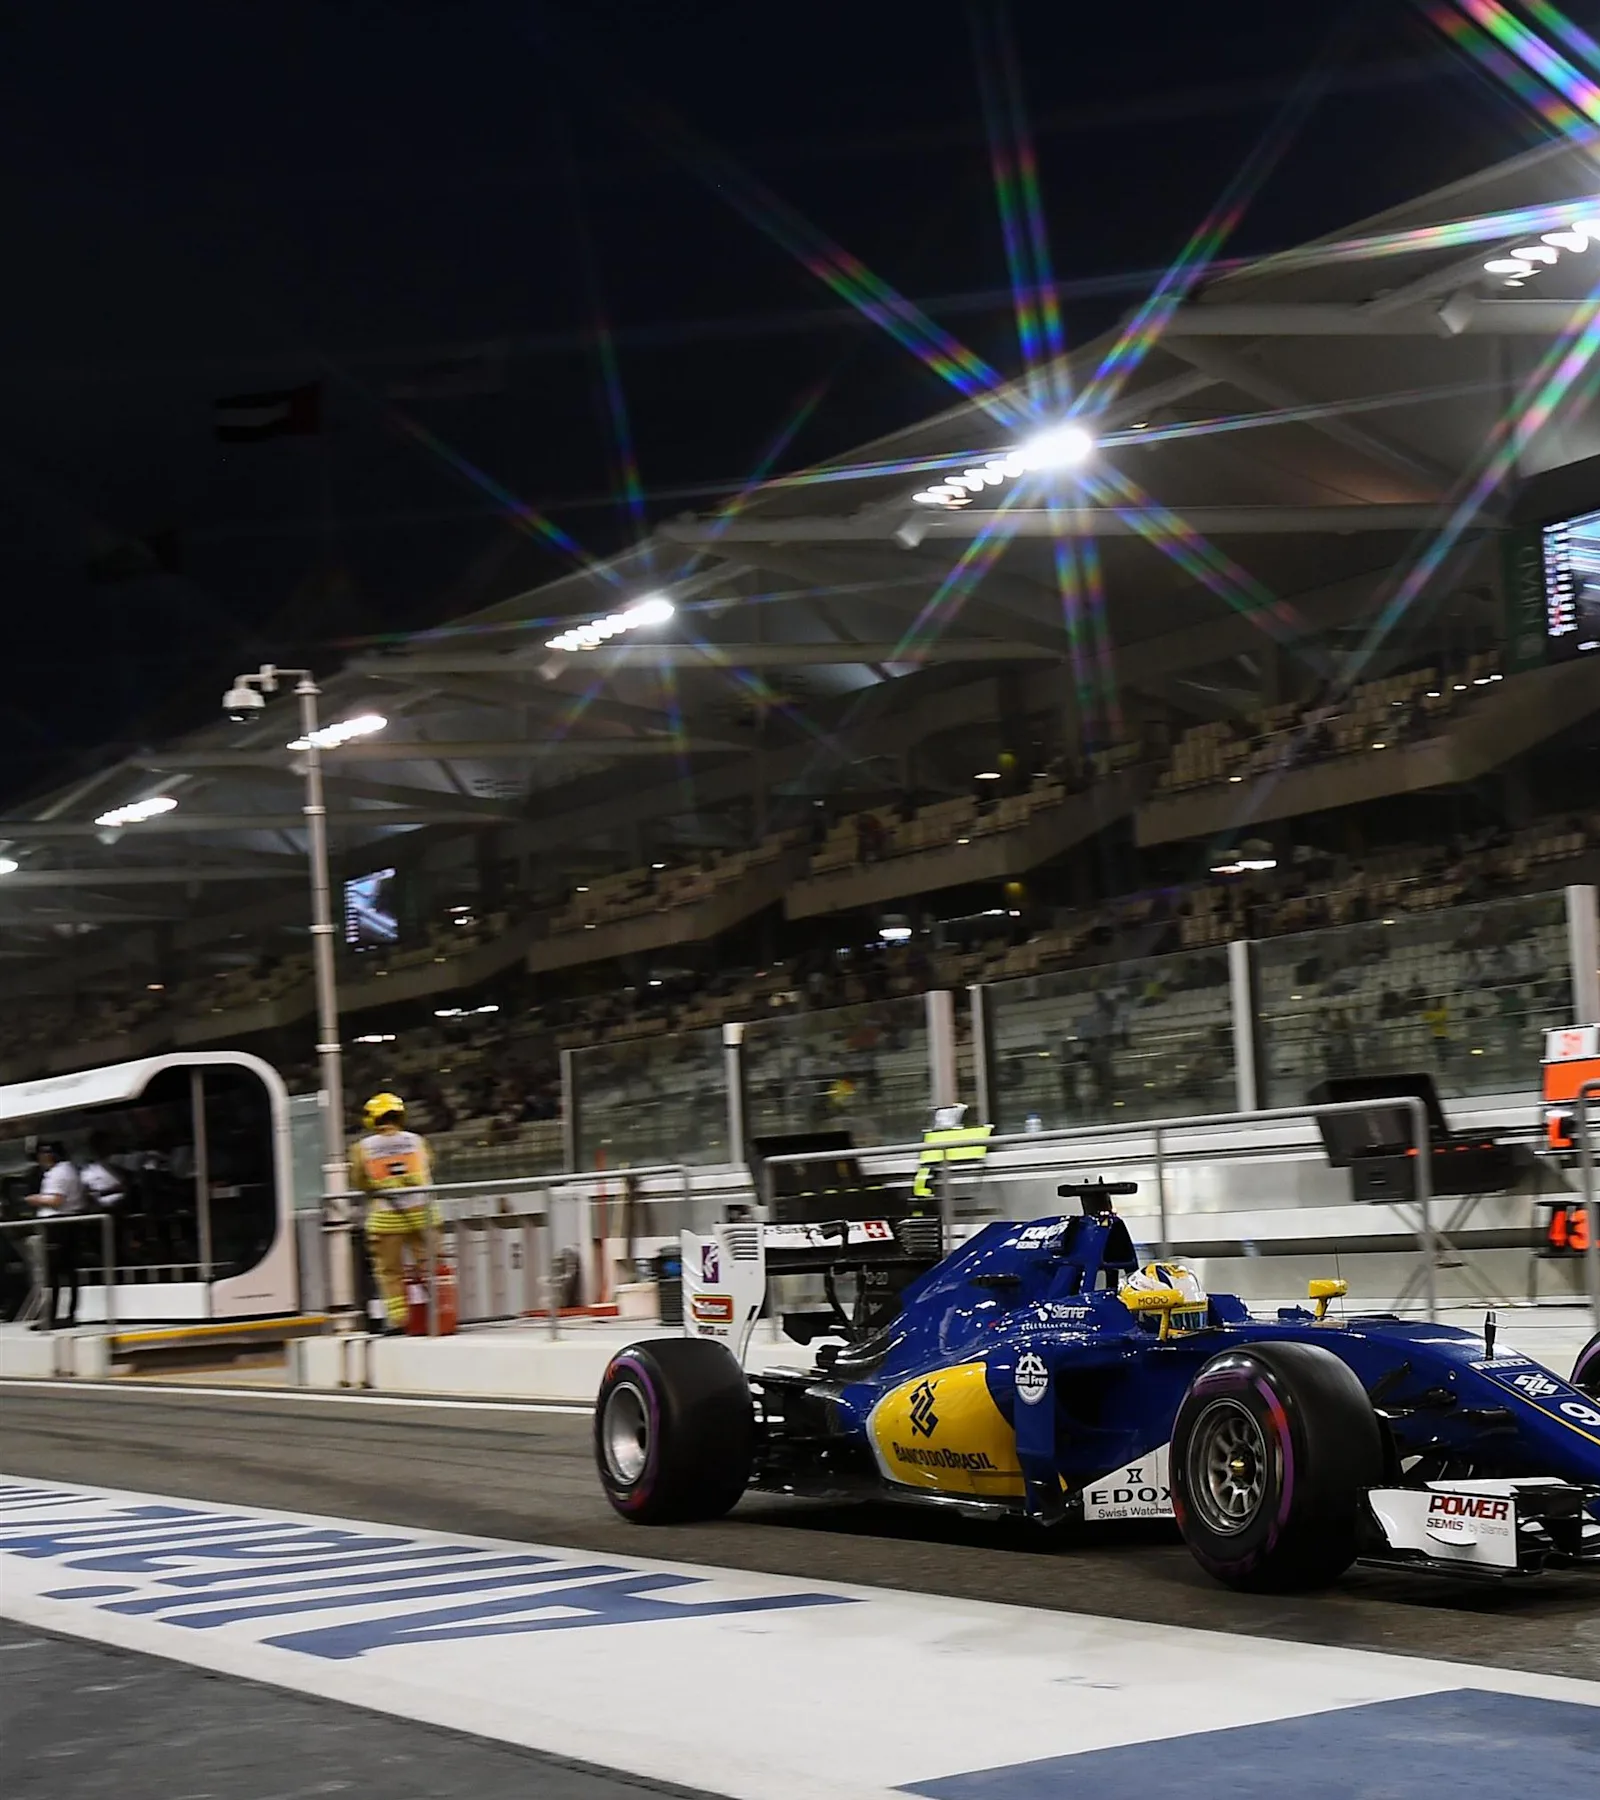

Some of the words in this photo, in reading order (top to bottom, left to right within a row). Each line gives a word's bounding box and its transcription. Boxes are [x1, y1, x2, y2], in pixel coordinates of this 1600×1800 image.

[1138, 1297, 1169, 1306] MODO
[1031, 1375, 1048, 1387] Frey
[1091, 1486, 1172, 1505] EDOX
[1098, 1506, 1128, 1519] Swiss
[1130, 1506, 1173, 1517] Watches
[1428, 1495, 1509, 1521] POWER
